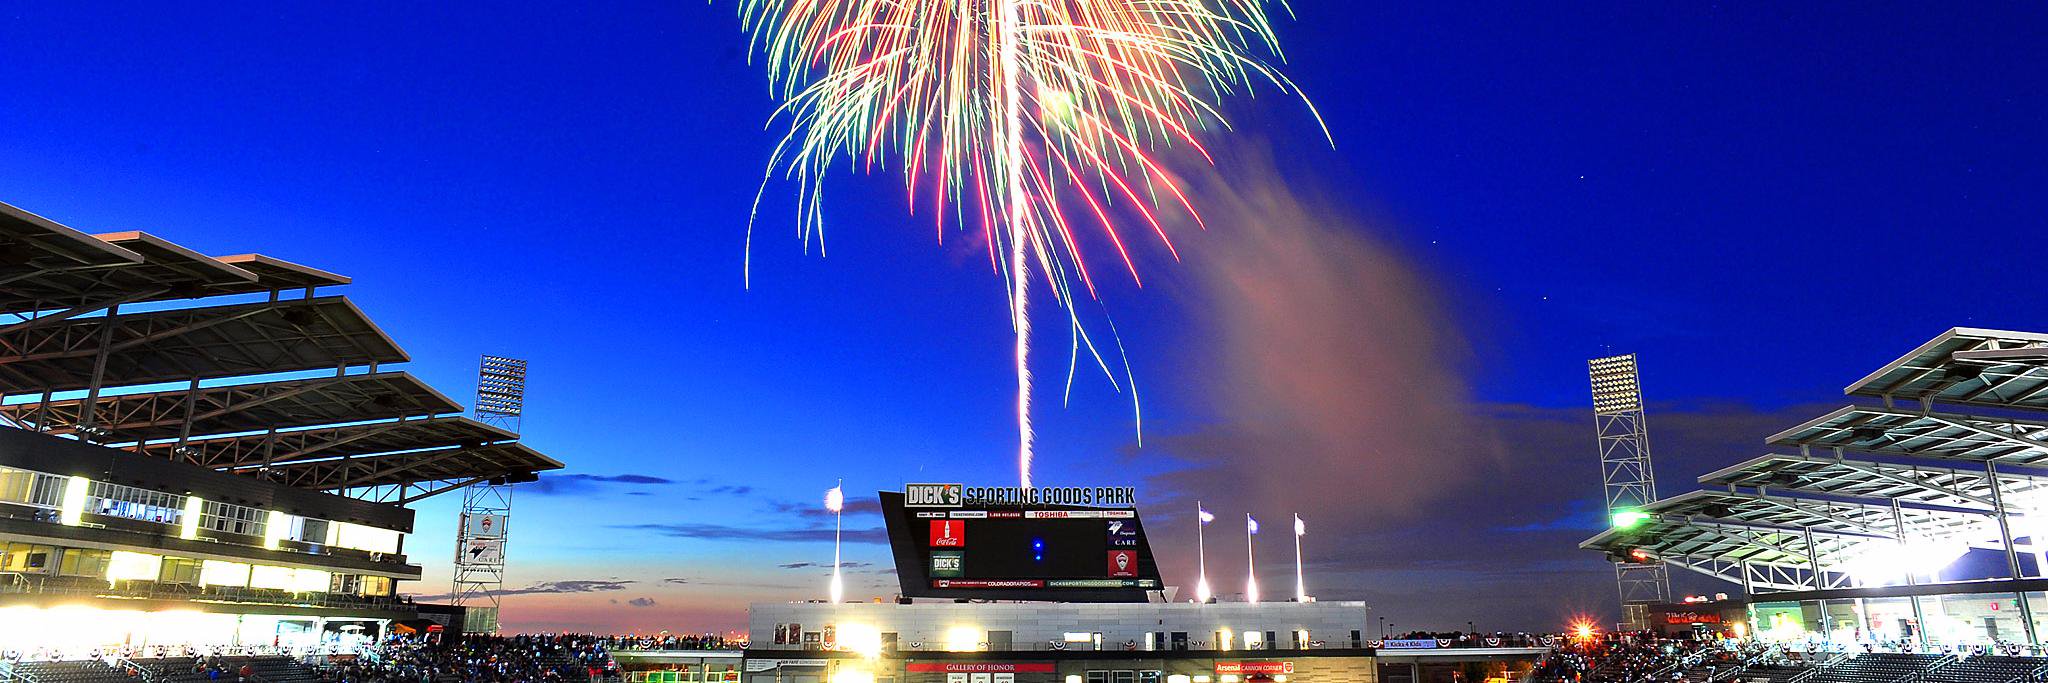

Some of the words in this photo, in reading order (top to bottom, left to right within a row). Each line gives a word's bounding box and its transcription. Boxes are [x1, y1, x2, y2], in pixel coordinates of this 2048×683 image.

[908, 486, 959, 504] DICK'S
[966, 487, 1039, 505] SPORTING
[1042, 487, 1092, 505] GOODS
[1095, 487, 1135, 505] PARK
[934, 558, 960, 568] DICK'S
[946, 663, 974, 671] GALLERY
[976, 663, 986, 671] OF
[988, 663, 1015, 671] HONOR
[1217, 664, 1240, 672] Arsenal
